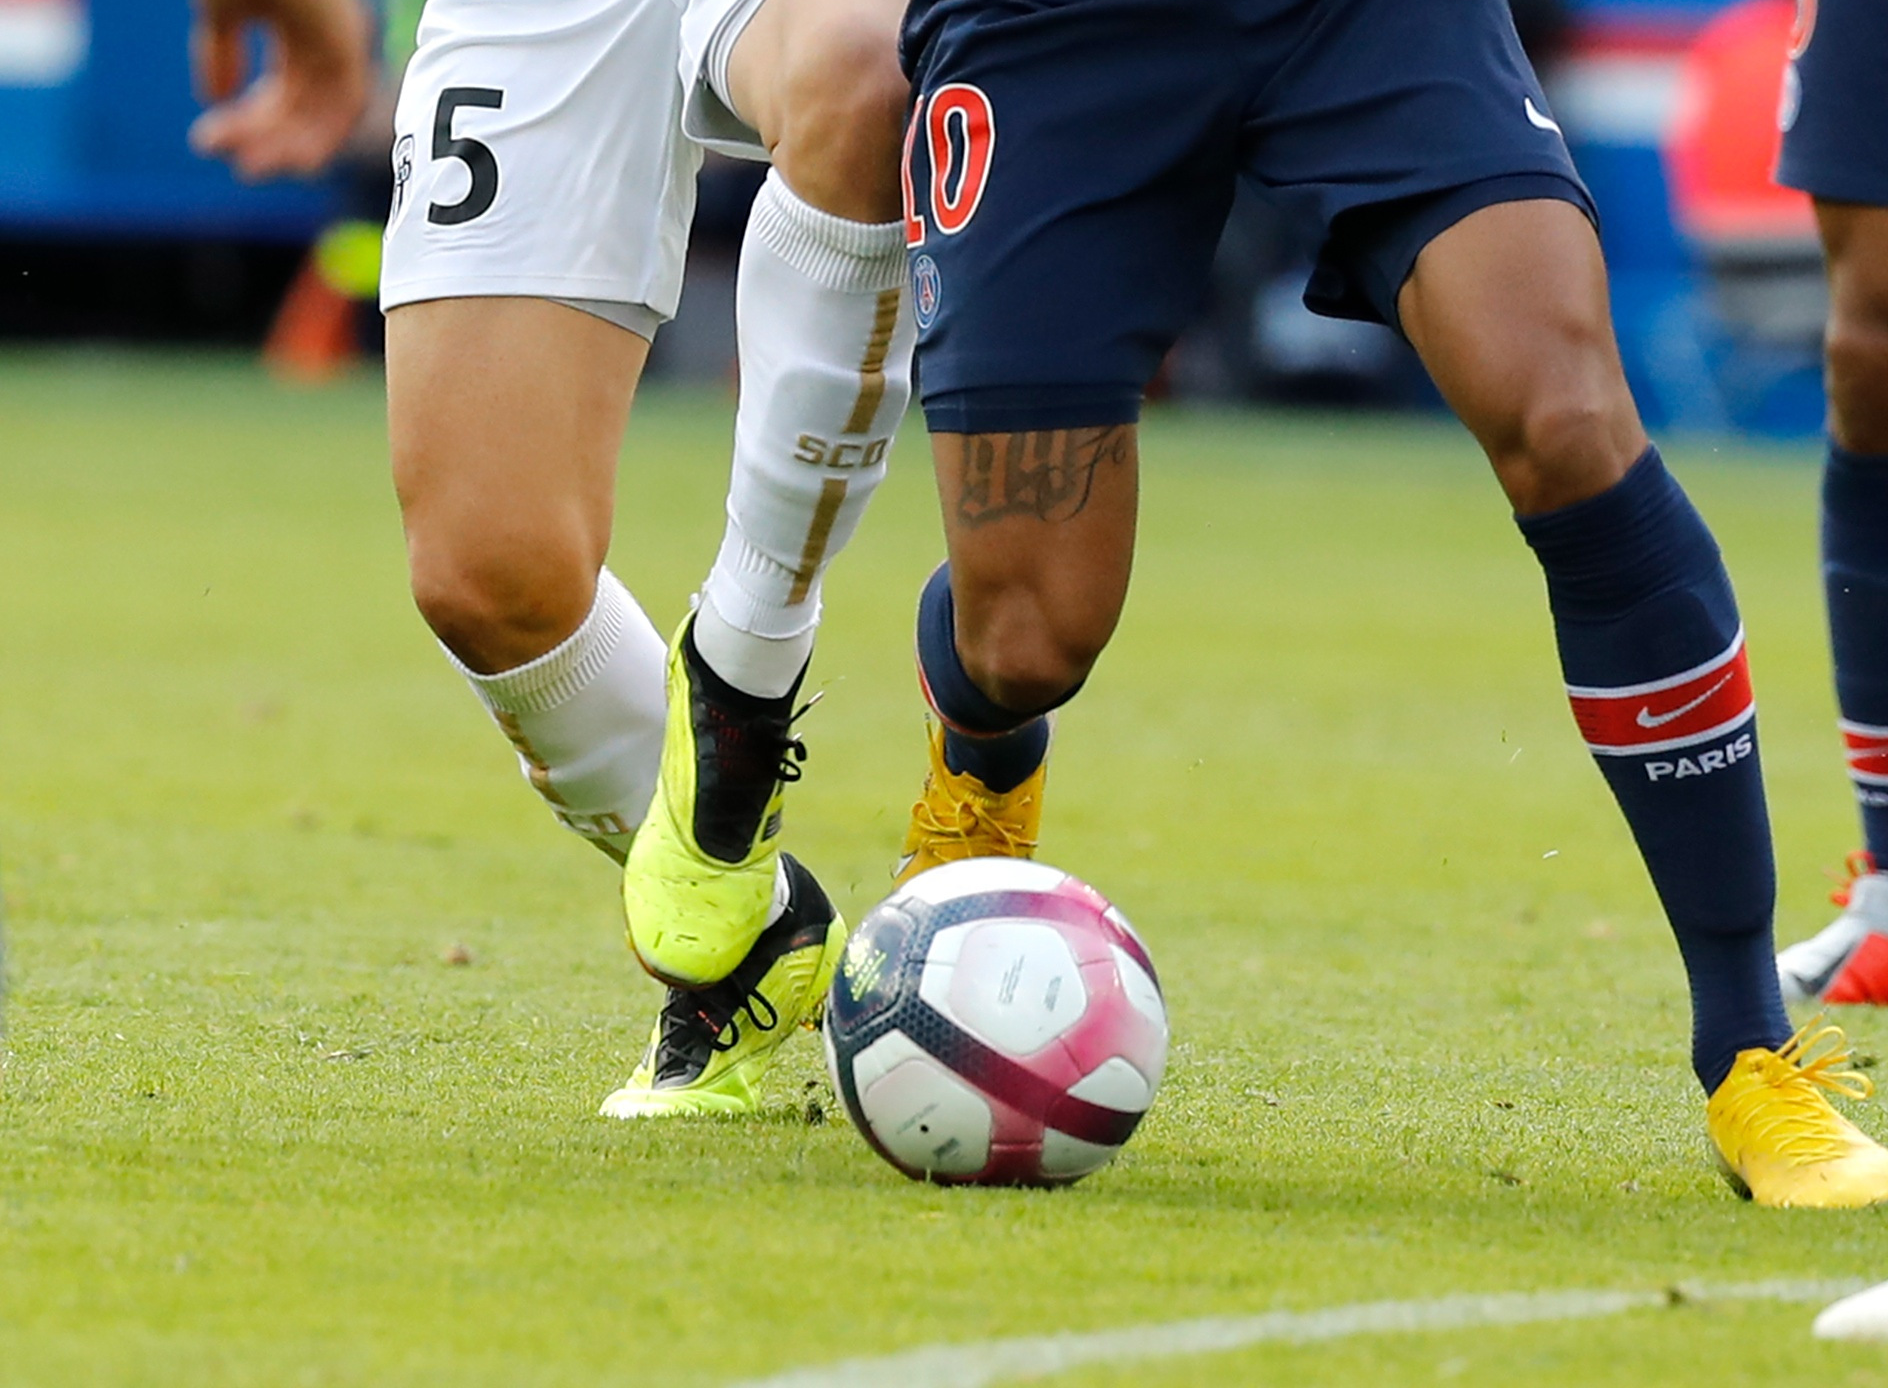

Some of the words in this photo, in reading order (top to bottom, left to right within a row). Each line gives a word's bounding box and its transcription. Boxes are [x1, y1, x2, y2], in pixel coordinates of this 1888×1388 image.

[427, 86, 504, 226] 5
[794, 433, 889, 469] SCO
[1645, 732, 1754, 783] PARIS
